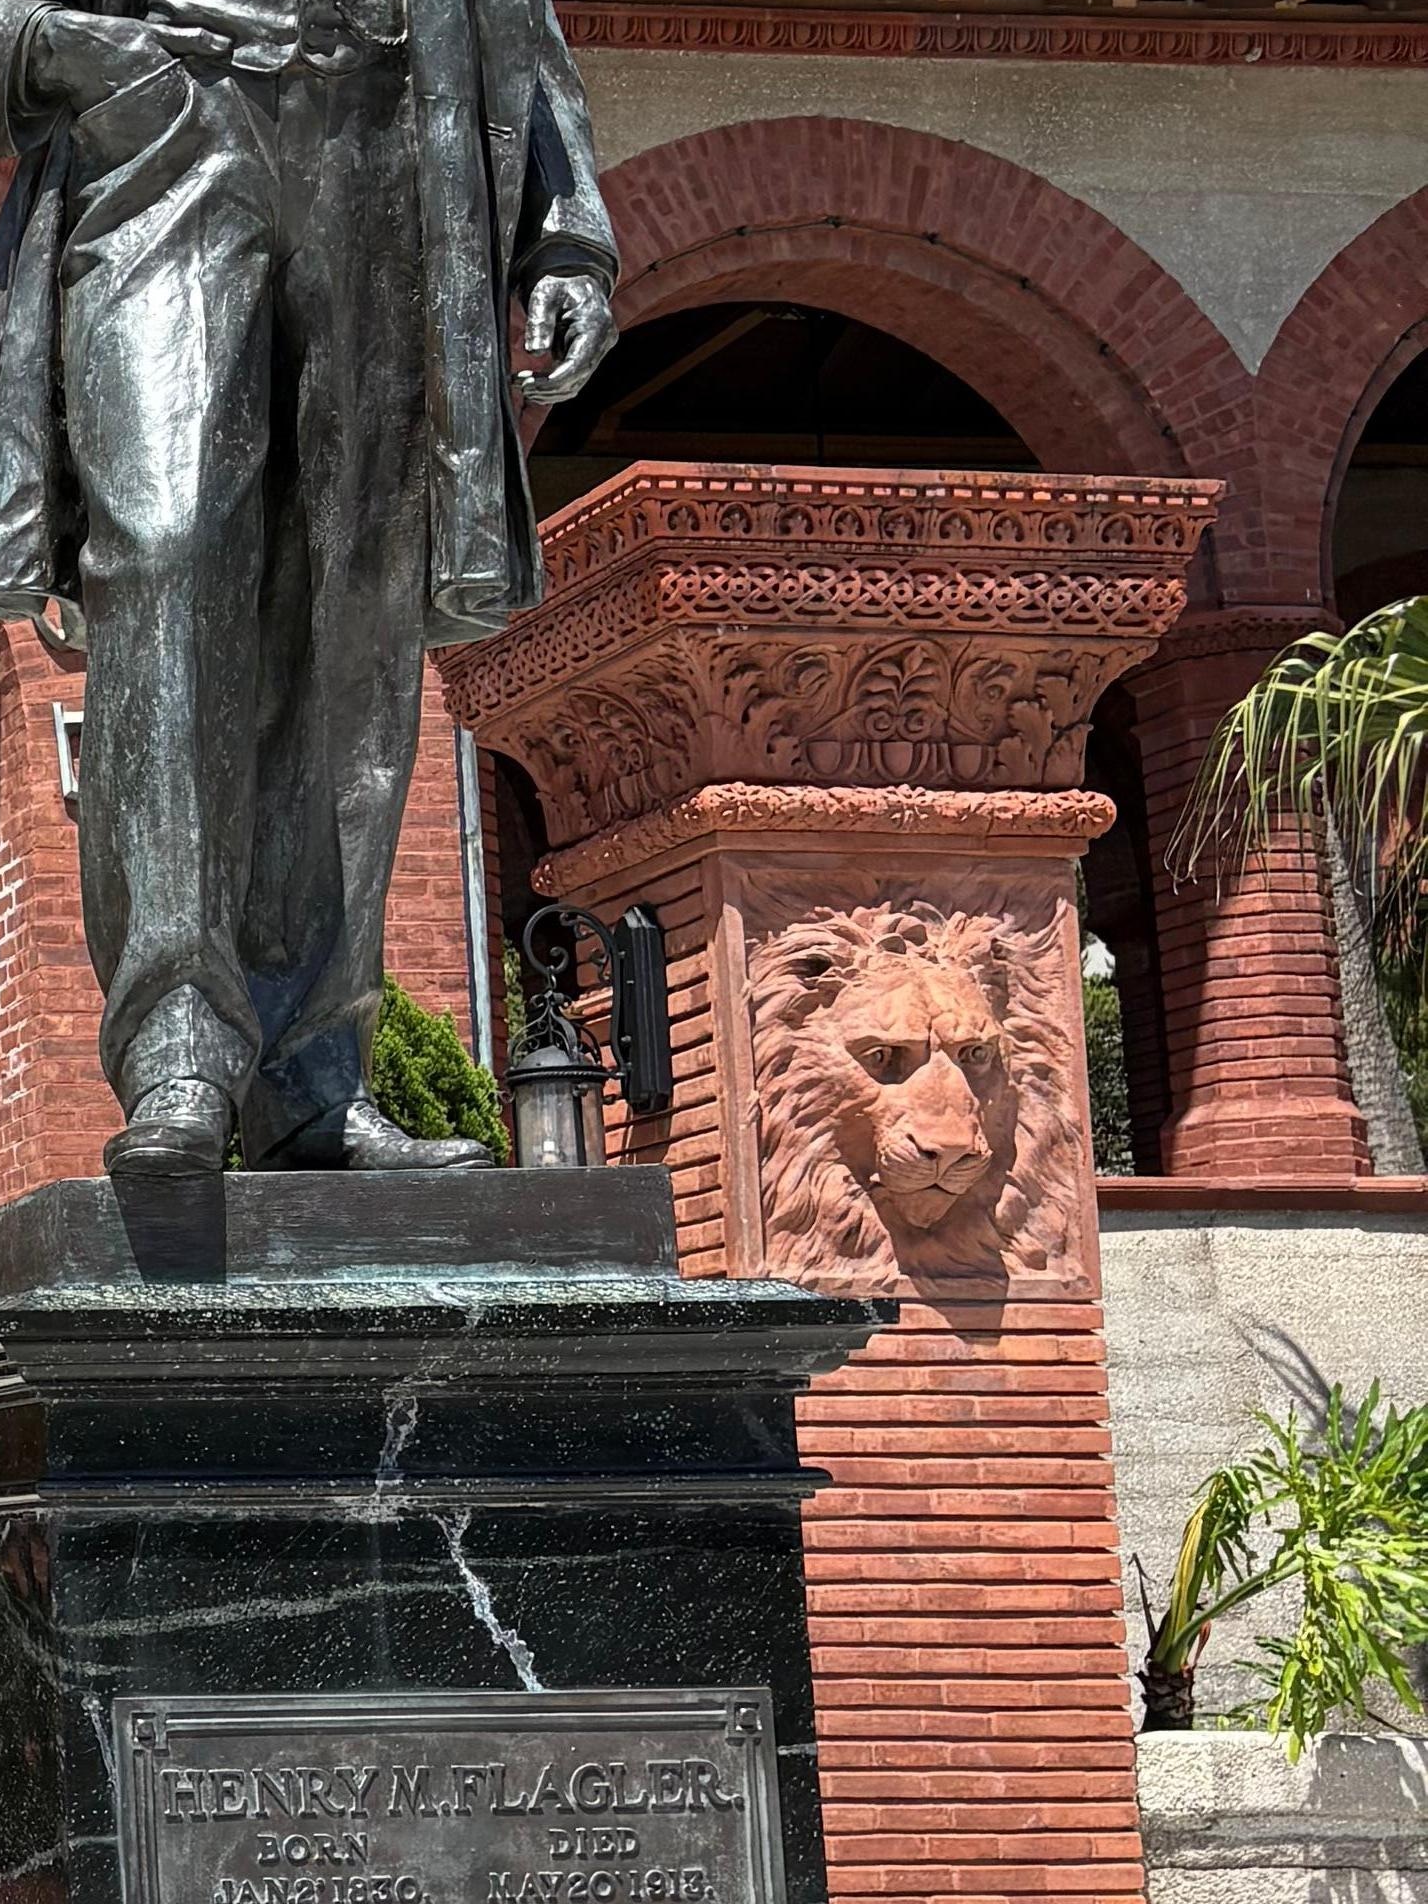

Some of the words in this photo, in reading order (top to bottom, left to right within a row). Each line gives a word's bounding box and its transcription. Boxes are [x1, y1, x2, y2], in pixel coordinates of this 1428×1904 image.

[160, 1765, 381, 1824] HENRY
[256, 1831, 369, 1866] BORN
[547, 1827, 641, 1861] DIED
